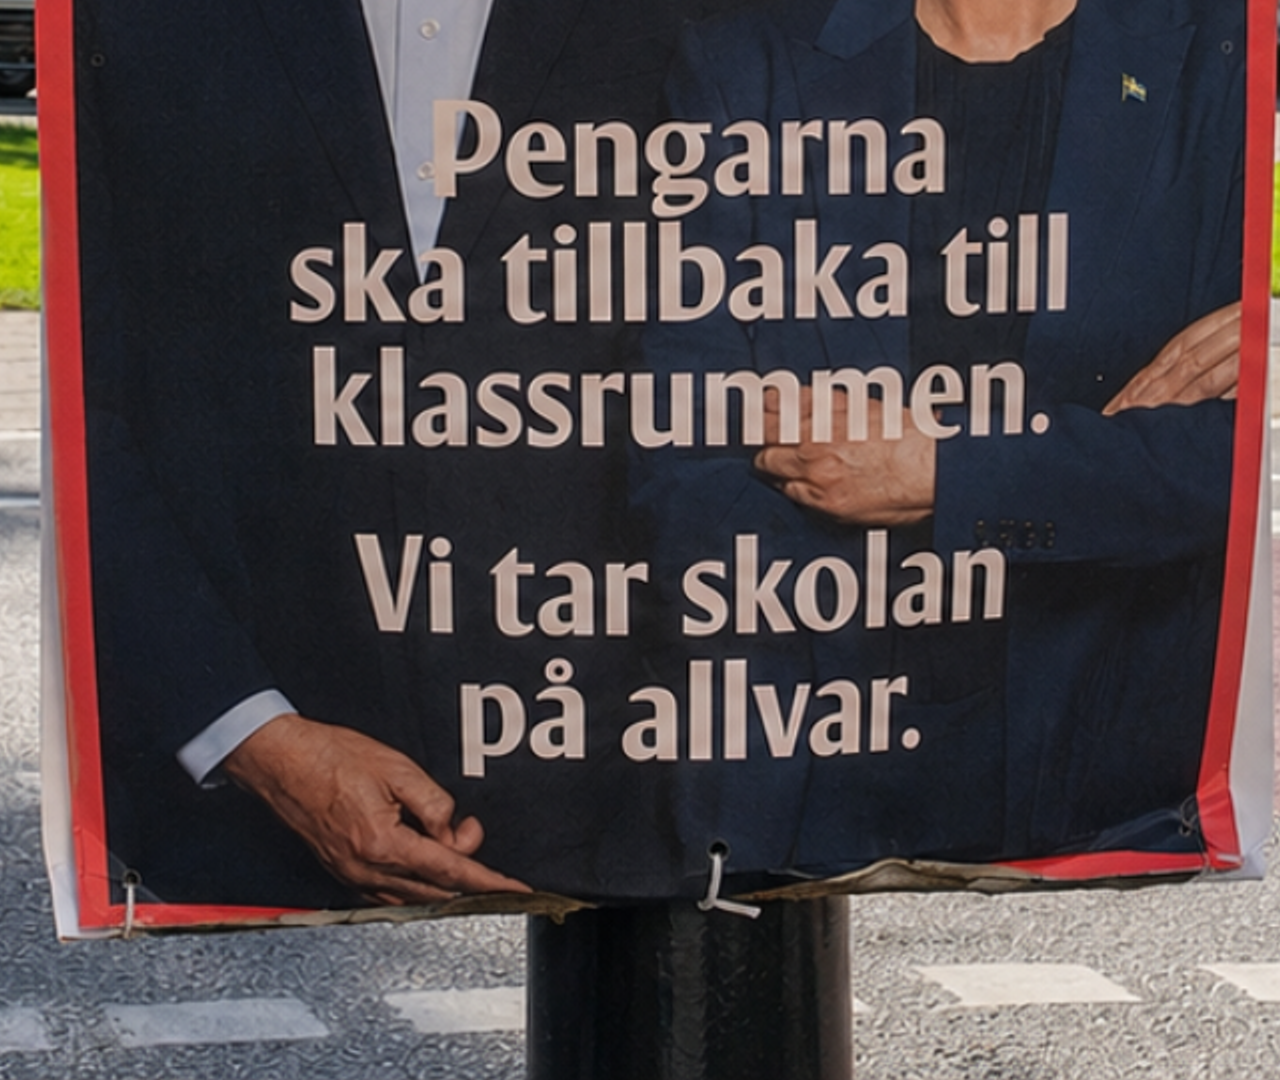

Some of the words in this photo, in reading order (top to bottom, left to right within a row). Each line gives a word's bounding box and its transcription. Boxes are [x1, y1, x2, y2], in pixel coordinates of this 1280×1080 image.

[431, 98, 947, 219] Pengarna
[288, 221, 466, 323] ska
[499, 218, 910, 323] tillbaka
[940, 212, 1070, 316] till
[312, 345, 1051, 448] klassrummen.
[353, 533, 454, 634] Vi
[488, 547, 650, 638] tar
[680, 529, 1006, 638] skolan
[459, 657, 587, 778] på
[620, 657, 922, 763] allvar.
